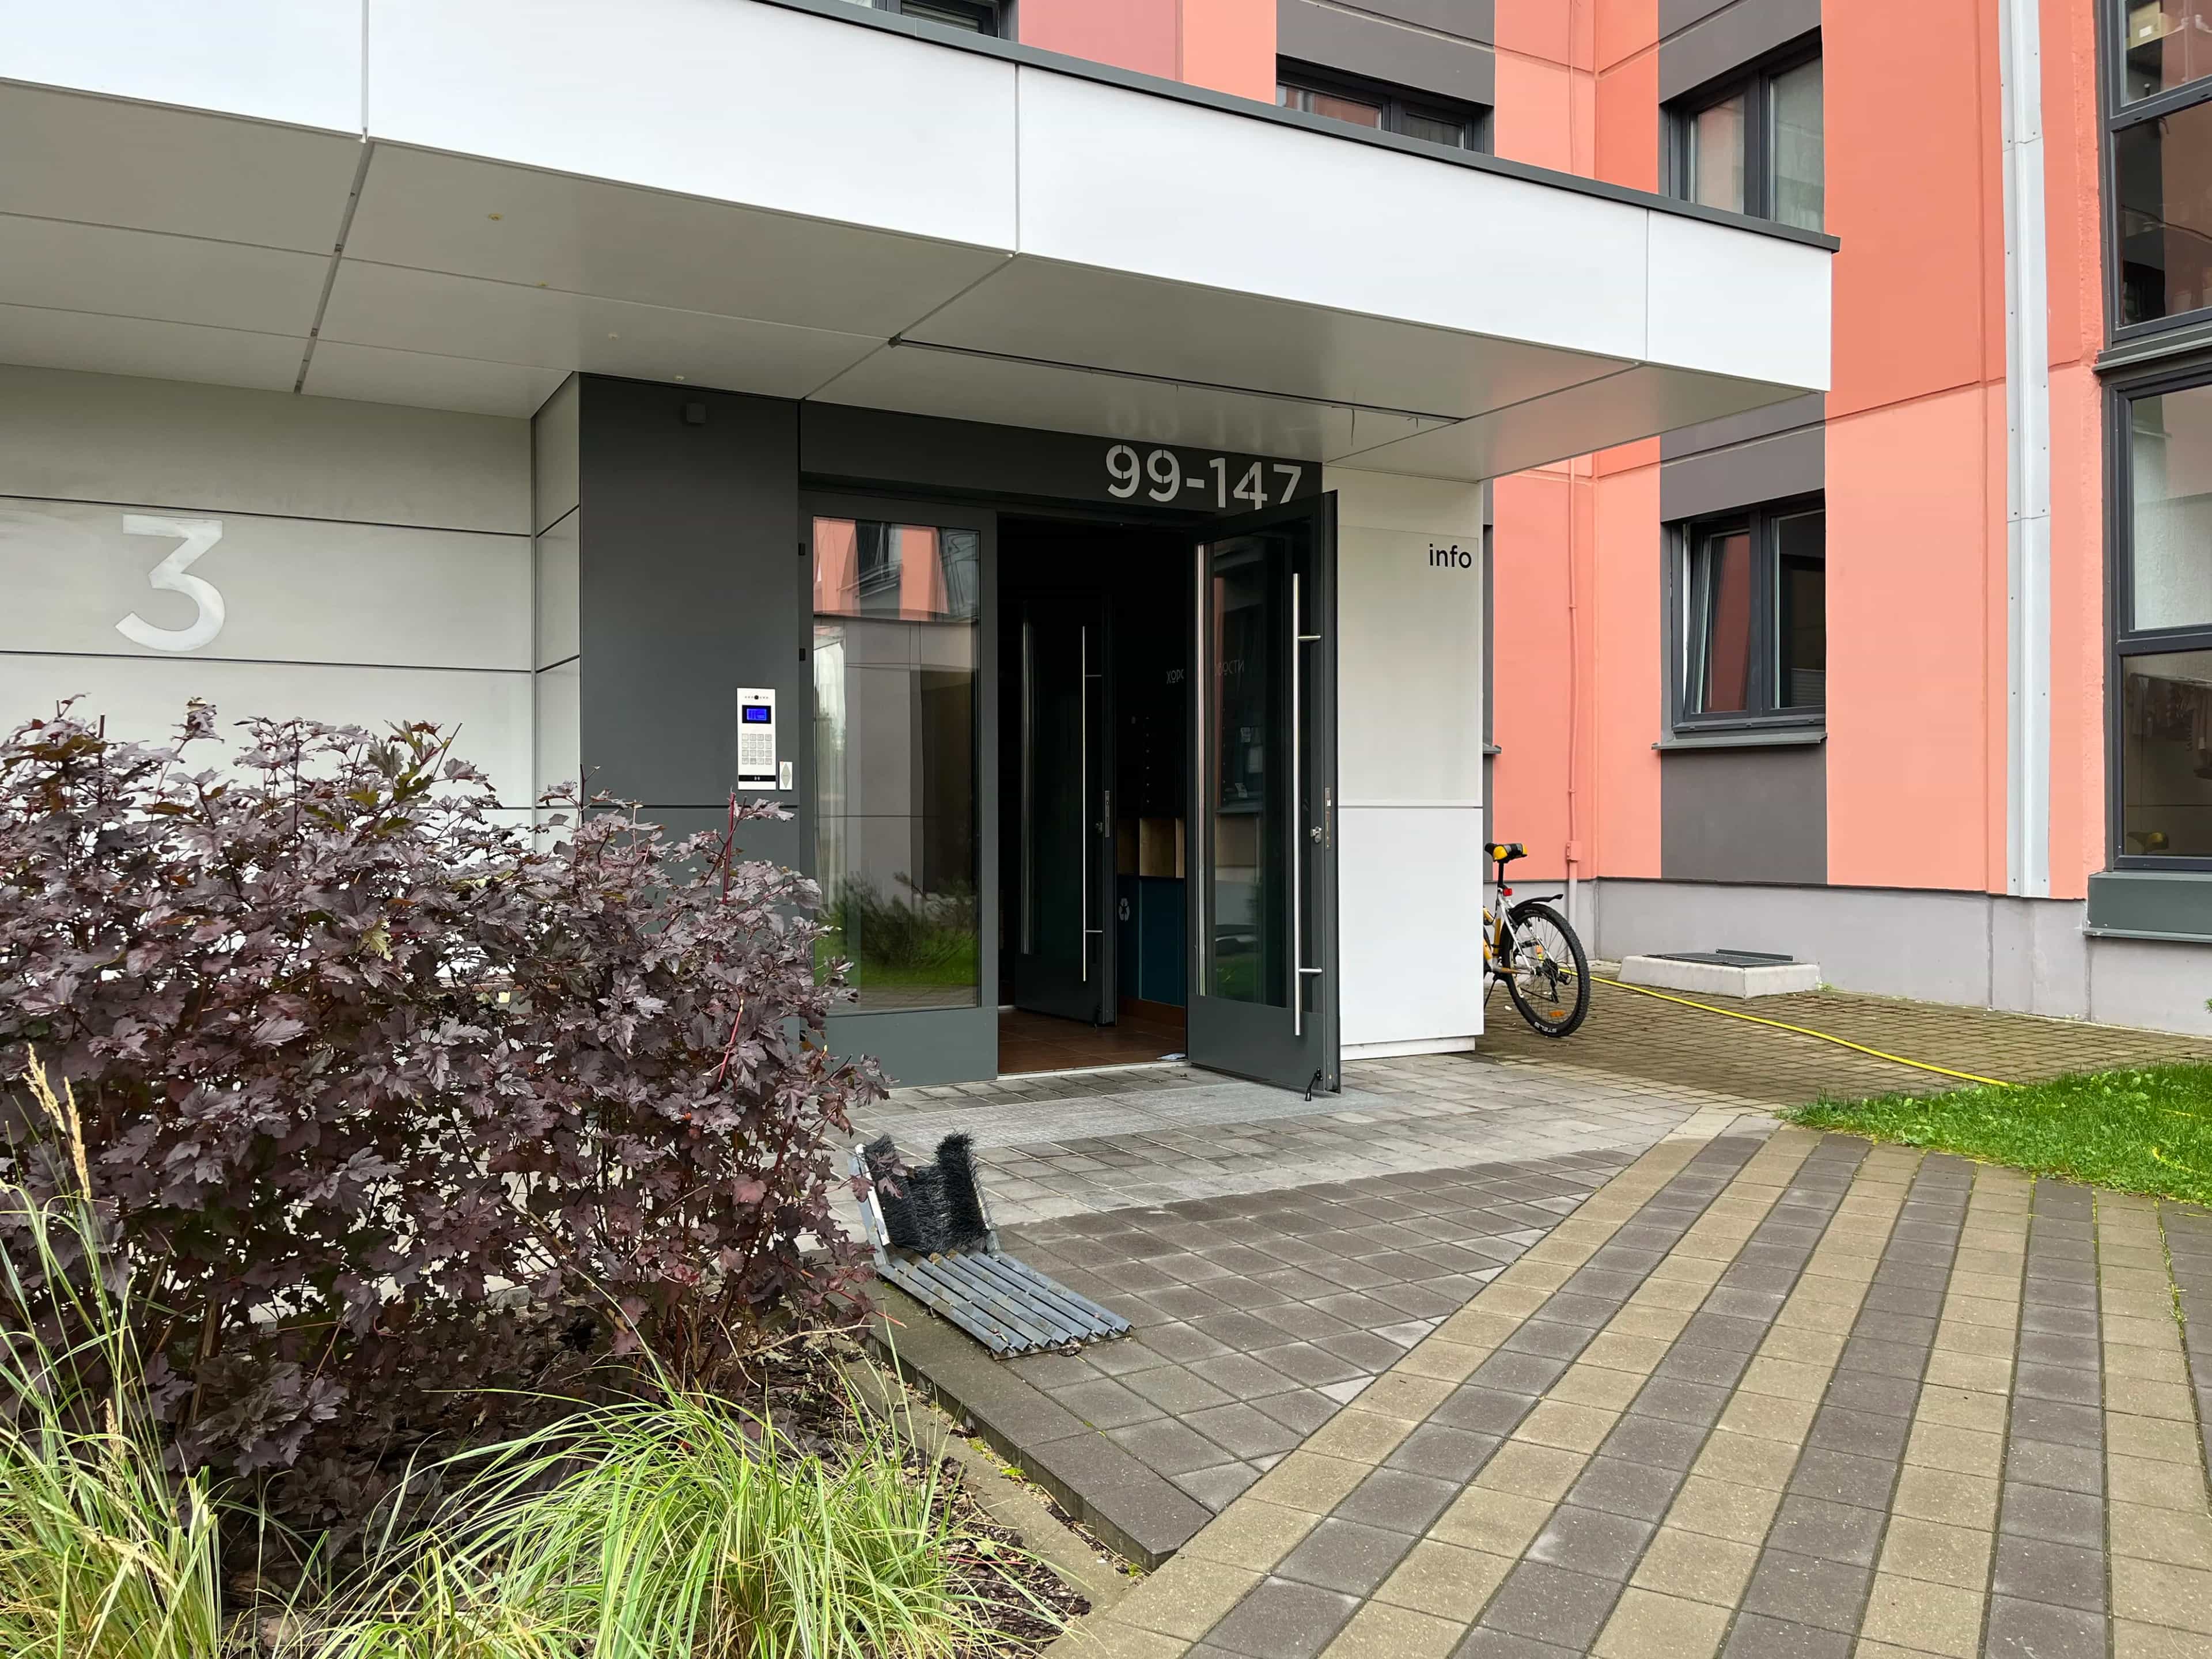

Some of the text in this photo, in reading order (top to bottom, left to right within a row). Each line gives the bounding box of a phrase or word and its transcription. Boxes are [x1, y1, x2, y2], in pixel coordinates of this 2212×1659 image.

[1106, 445, 1302, 510] 99-147
[115, 513, 225, 652] 3
[1429, 543, 1472, 569] info
